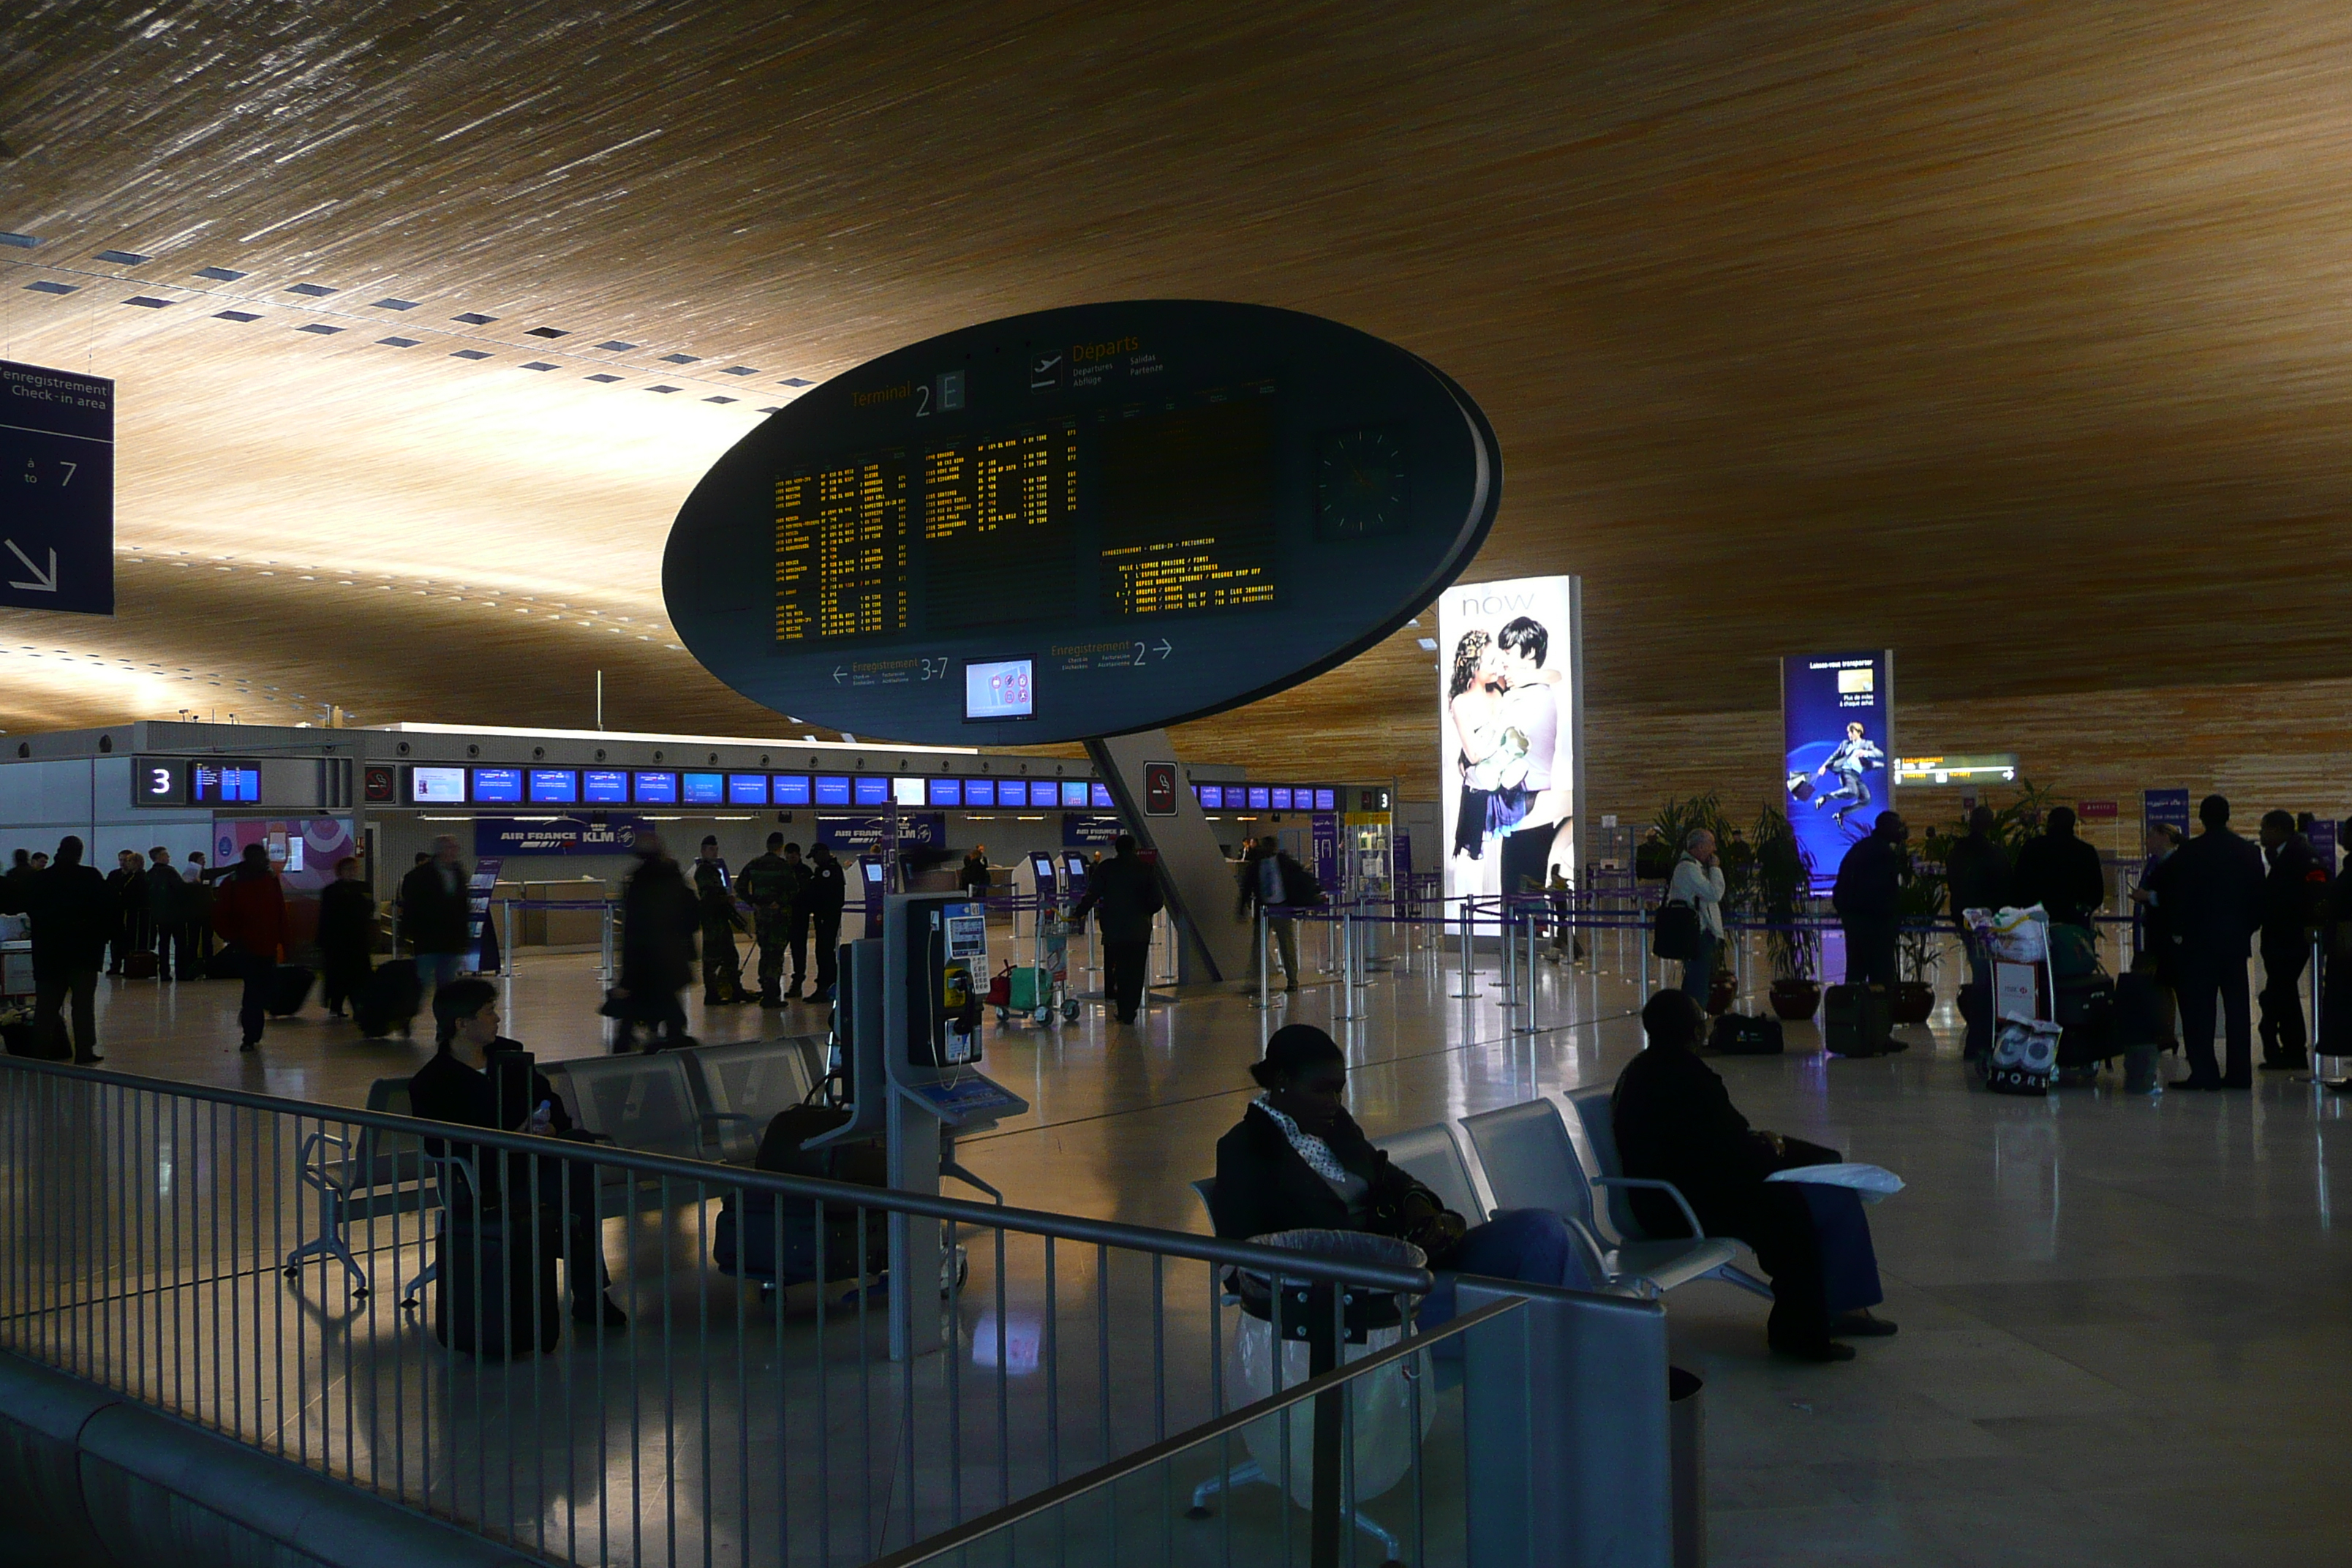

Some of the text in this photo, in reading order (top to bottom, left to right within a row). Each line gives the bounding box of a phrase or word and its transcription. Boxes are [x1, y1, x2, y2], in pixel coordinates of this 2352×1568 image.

[1073, 336, 1139, 362] Départs
[1130, 354, 1156, 365] Salidas
[1073, 363, 1113, 377] Departures
[1130, 363, 1164, 376] Partenze
[1073, 376, 1102, 388] Abflüge
[12, 385, 106, 410] Check-in area
[852, 376, 957, 418] Terminal 2 E
[24, 473, 37, 483] to
[60, 461, 77, 486] 7
[1463, 592, 1535, 617] now
[1051, 641, 1146, 666] Enregistrement 2
[852, 657, 949, 681] Enregistrement 3-7
[152, 769, 170, 794] 3
[1381, 793, 1388, 808] 3
[500, 832, 524, 840] AIR
[527, 832, 577, 840] FRANCE
[582, 832, 614, 843] KLM
